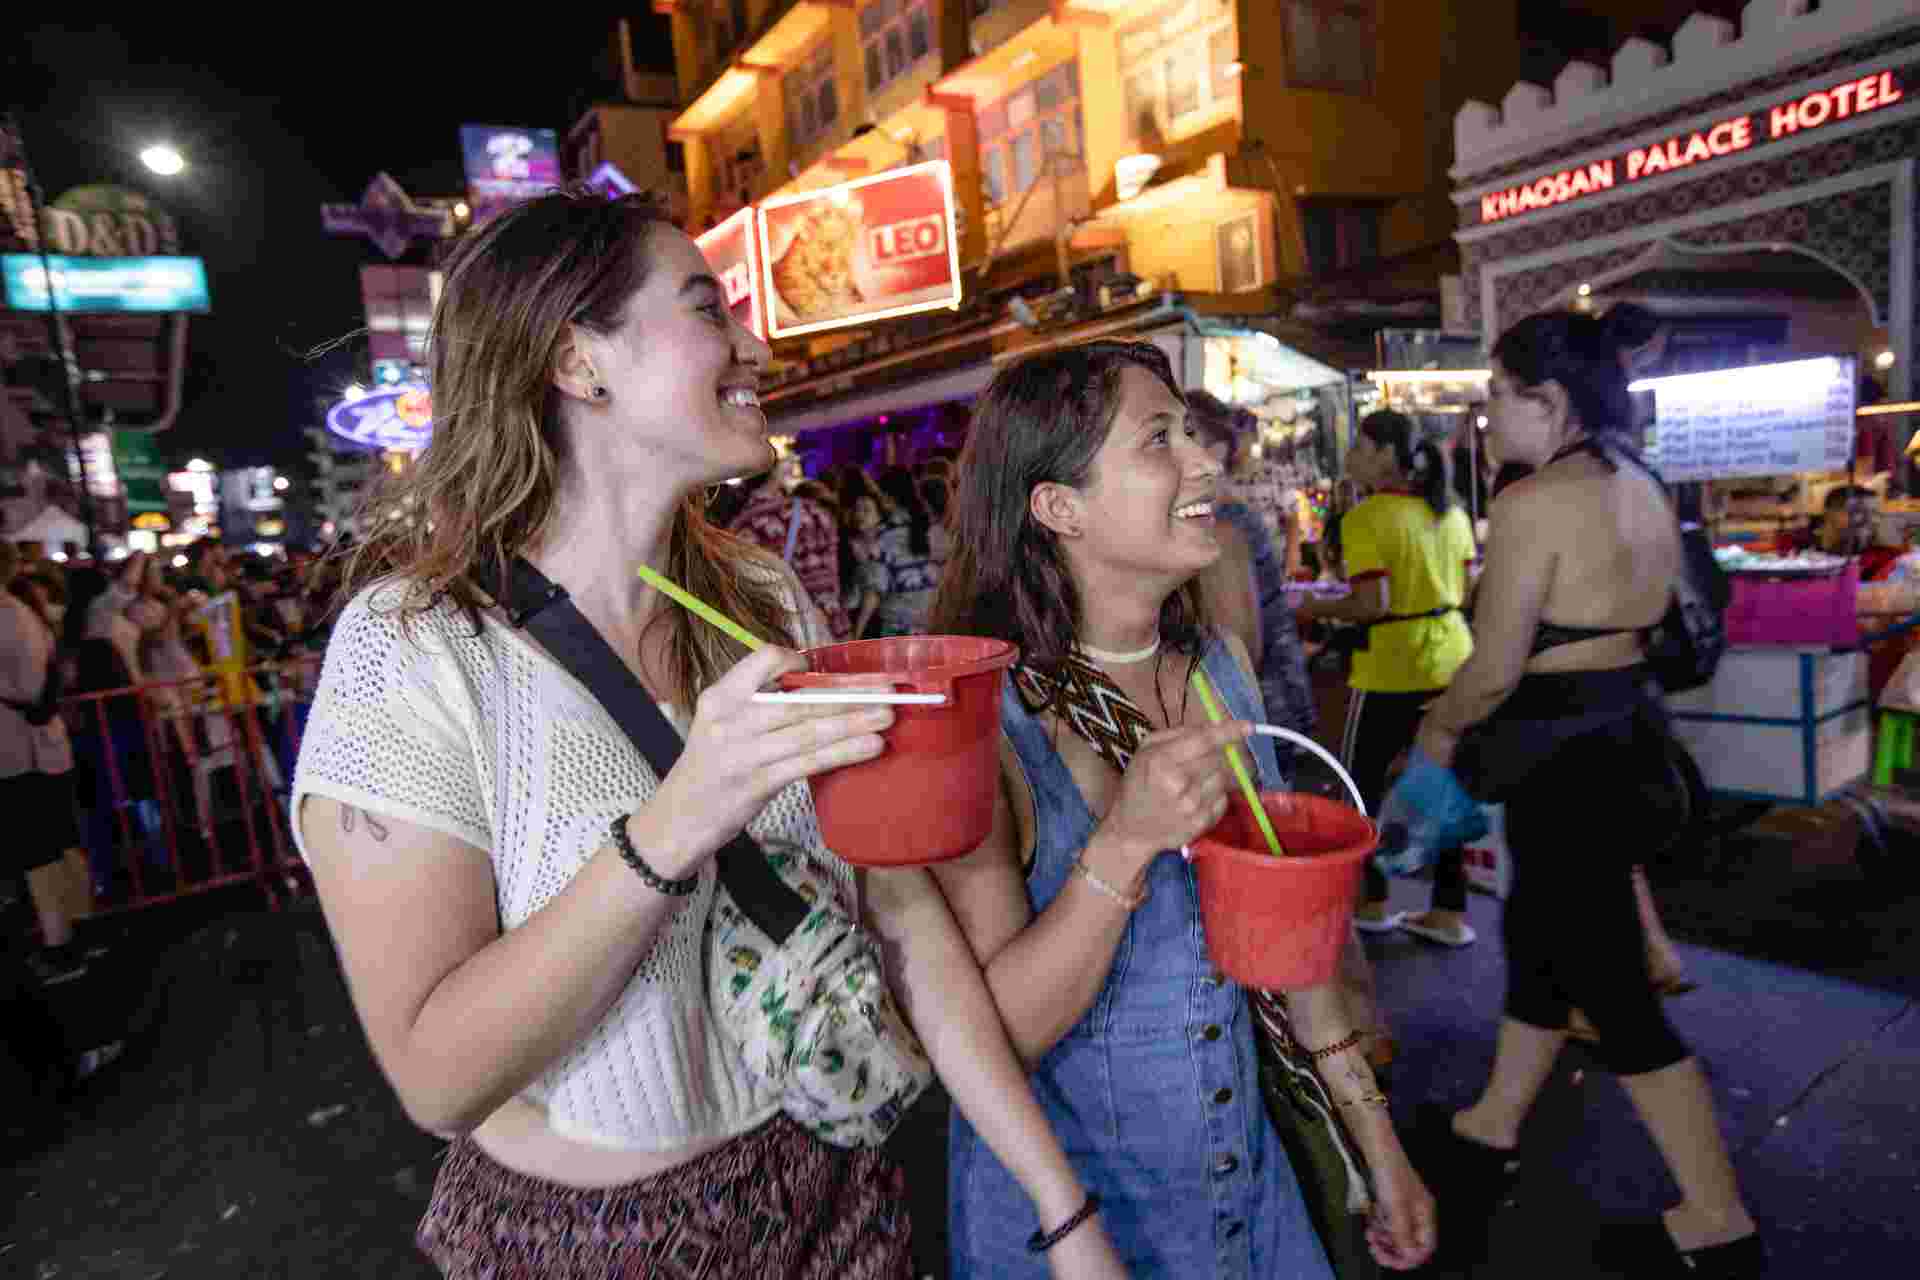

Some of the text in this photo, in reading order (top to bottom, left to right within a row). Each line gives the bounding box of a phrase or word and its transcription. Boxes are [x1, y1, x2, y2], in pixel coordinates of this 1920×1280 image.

[1480, 70, 1902, 224] KHAOSAN PALACE HOTEL
[874, 221, 941, 260] LEO
